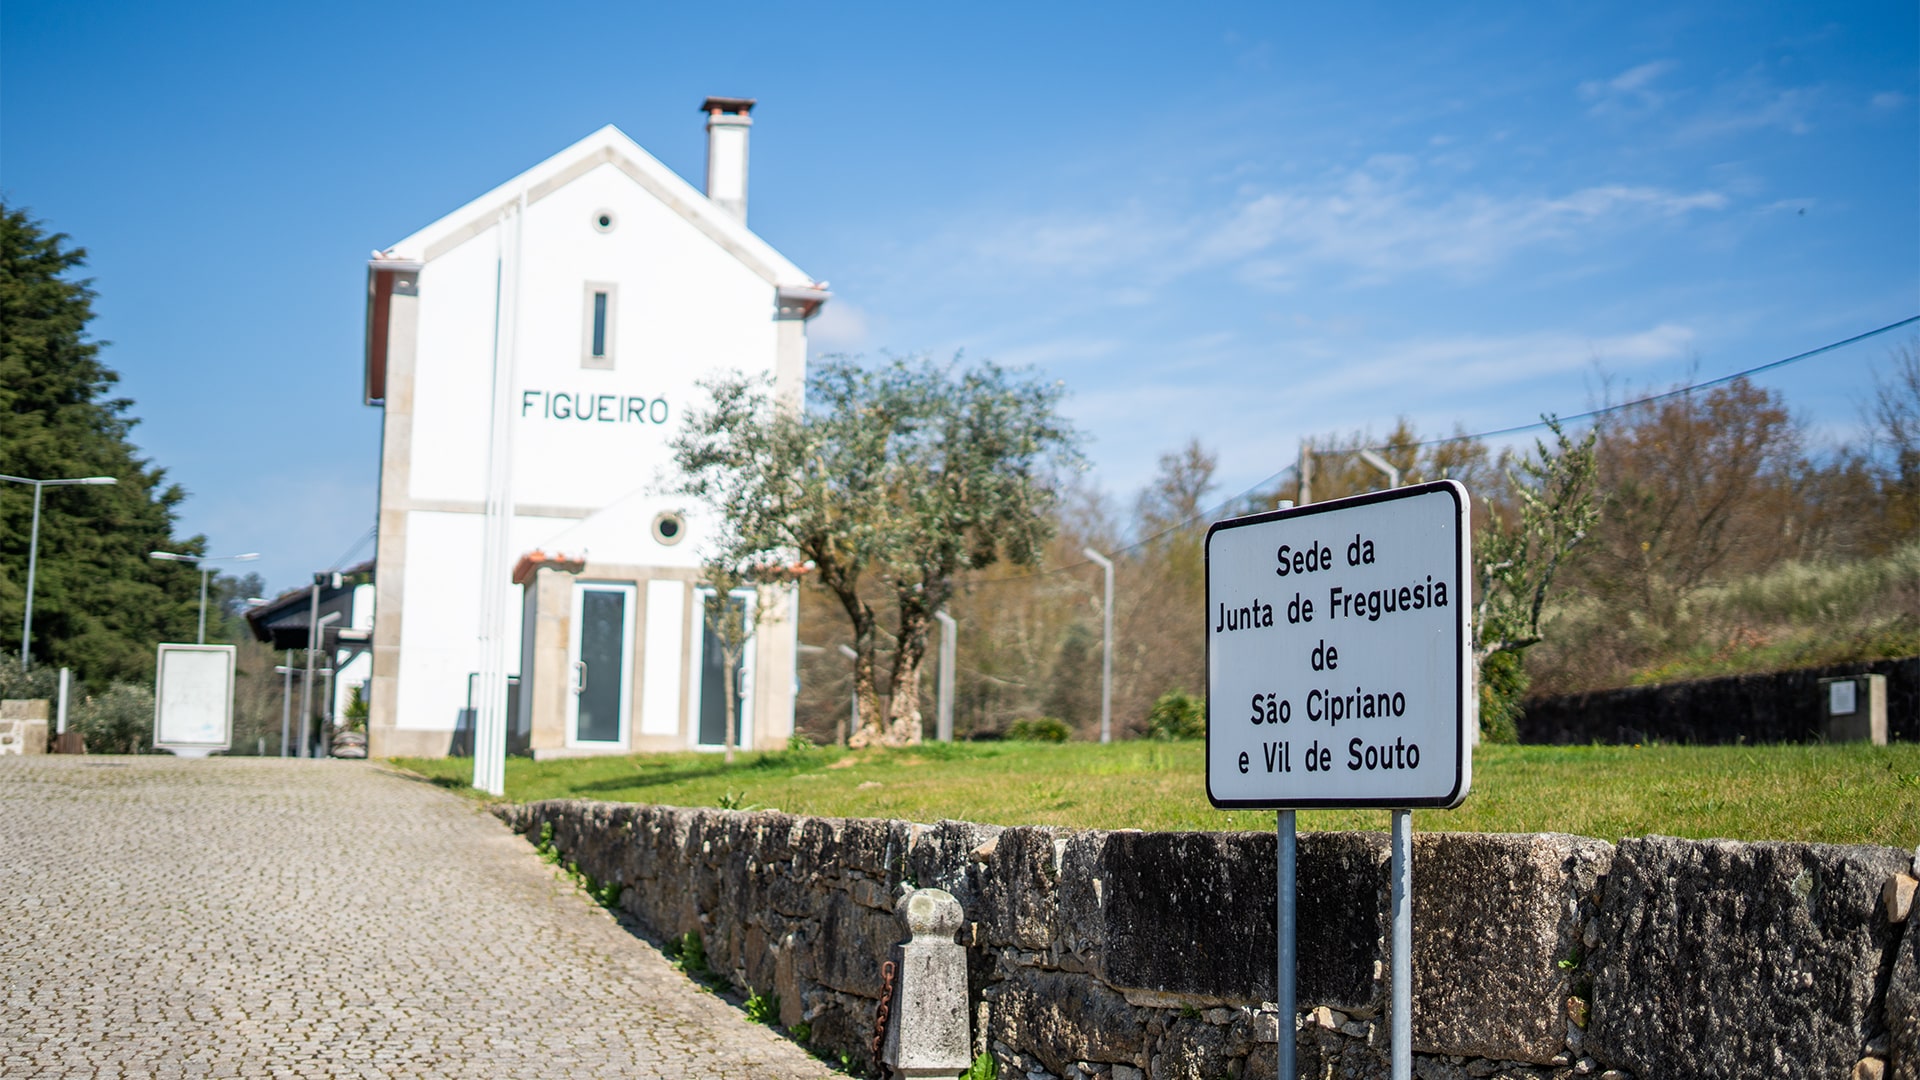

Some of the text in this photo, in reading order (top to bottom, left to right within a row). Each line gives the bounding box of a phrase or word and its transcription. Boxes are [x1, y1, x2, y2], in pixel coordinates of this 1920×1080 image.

[1275, 533, 1376, 577] Sede da
[1216, 574, 1449, 633] Junta de Freguesia
[1311, 639, 1339, 672] de
[1250, 686, 1406, 727] São Cipriano
[1238, 736, 1420, 775] e Vil de Souto
